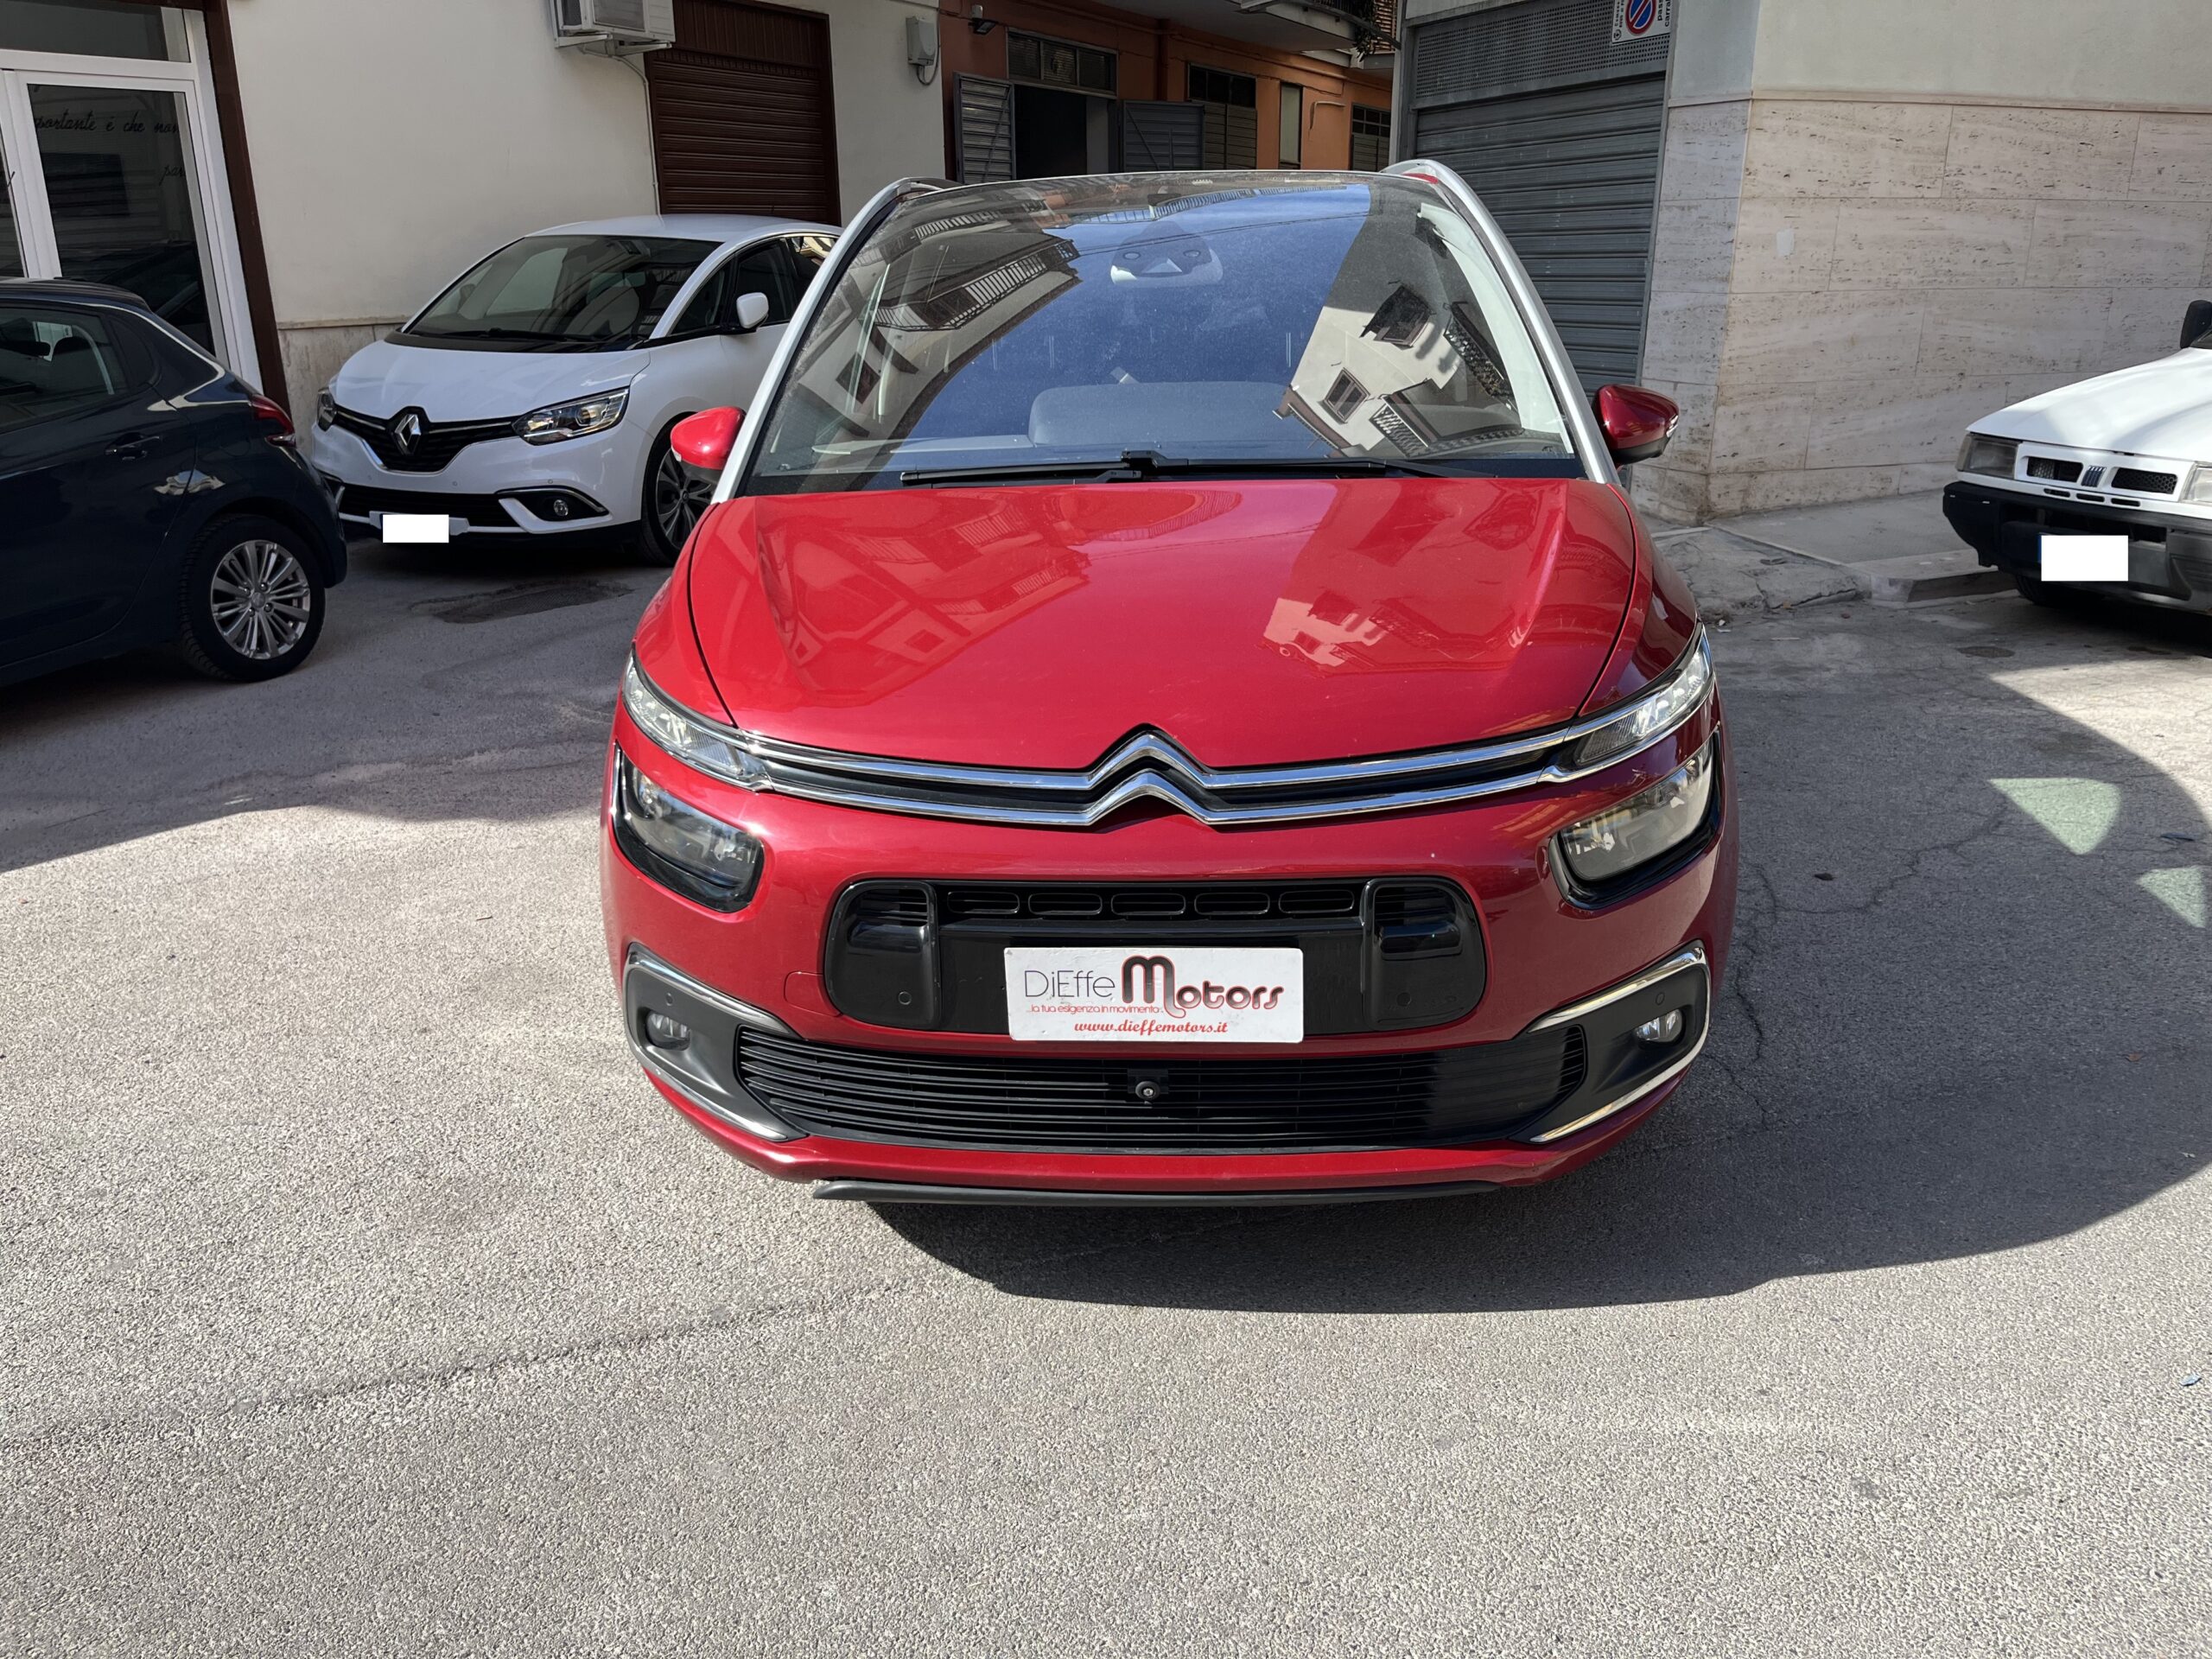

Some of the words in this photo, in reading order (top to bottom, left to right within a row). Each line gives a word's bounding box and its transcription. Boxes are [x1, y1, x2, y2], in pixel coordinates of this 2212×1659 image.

[1025, 970, 1116, 997] DiEffe
[1041, 1004, 1056, 1013] tua
[1058, 1004, 1100, 1014] esigenza
[1101, 1004, 1109, 1013] in
[1074, 1020, 1229, 1035] www.dieffemotors.it
